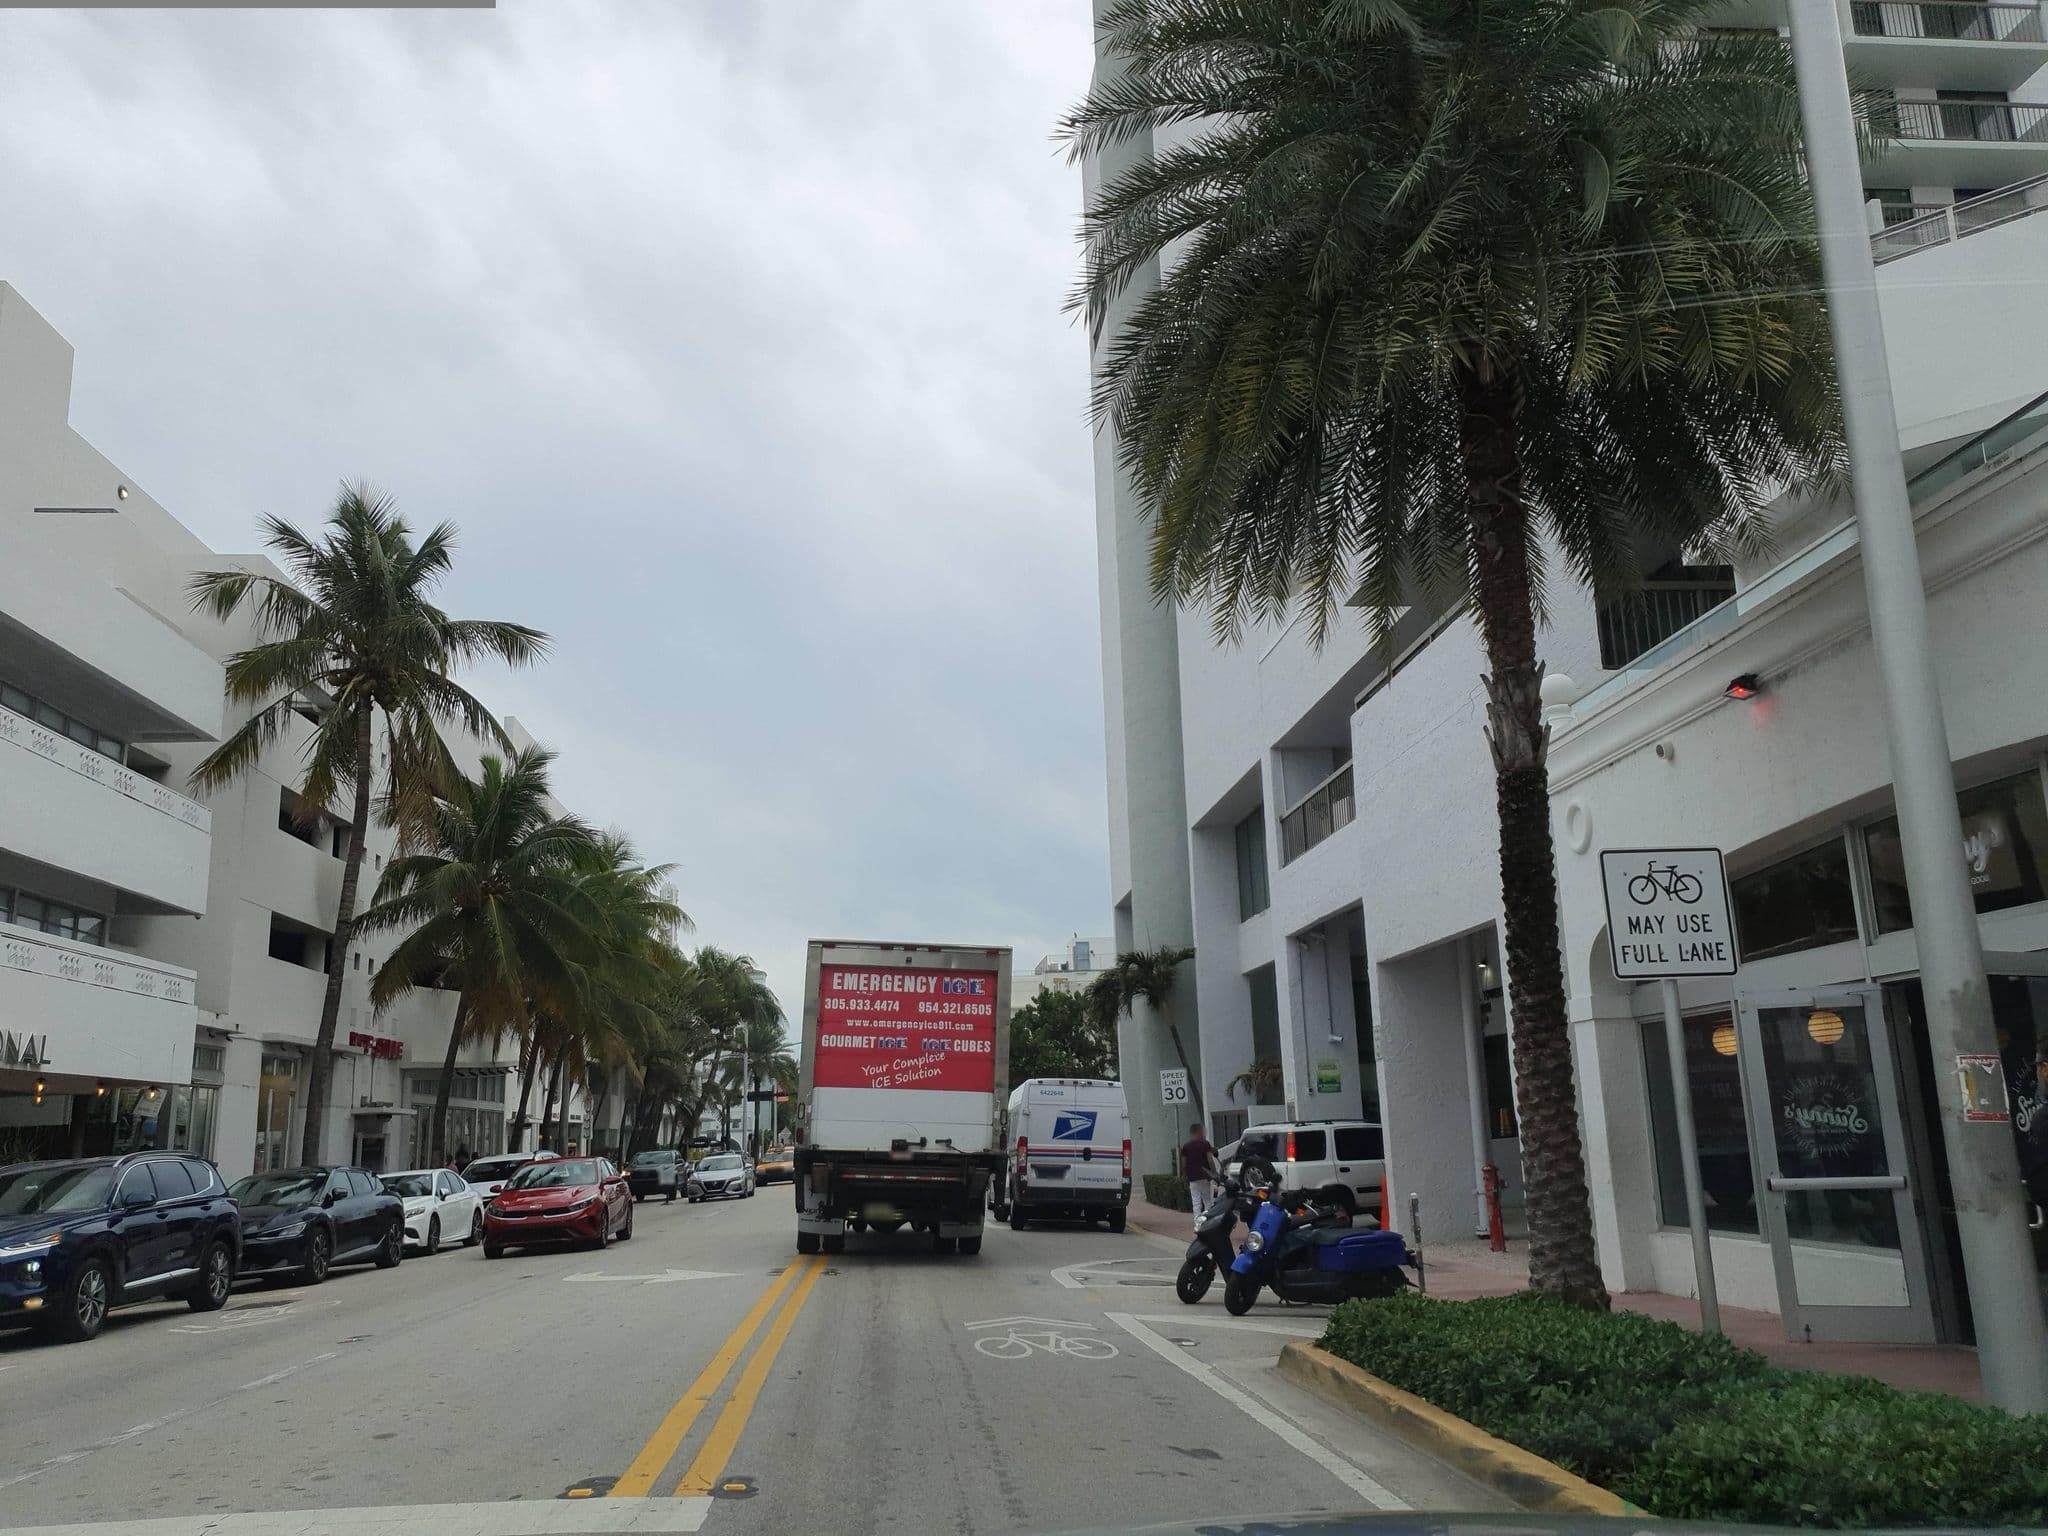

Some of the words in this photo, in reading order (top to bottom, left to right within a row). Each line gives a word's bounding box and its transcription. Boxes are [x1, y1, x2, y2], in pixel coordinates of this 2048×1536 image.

[1627, 915, 1665, 935] MAY
[1676, 913, 1713, 934] USE
[1621, 943, 1669, 964] FULL
[1678, 942, 1727, 962] LANE
[832, 972, 938, 994] EMERGENCY
[942, 976, 986, 996] ICE
[824, 998, 900, 1012] 305.933.4474
[0, 1030, 51, 1065] NAL
[821, 1034, 877, 1049] GOURMET
[877, 1035, 908, 1049] ICE
[921, 1037, 952, 1051] ICE
[953, 1039, 992, 1053] CUBES
[861, 1062, 889, 1077] Your
[892, 1050, 946, 1071] Complete
[871, 1075, 892, 1089] ICE
[895, 1066, 943, 1085] Solution
[1162, 1072, 1185, 1080] SPEED
[1164, 1086, 1186, 1101] 30
